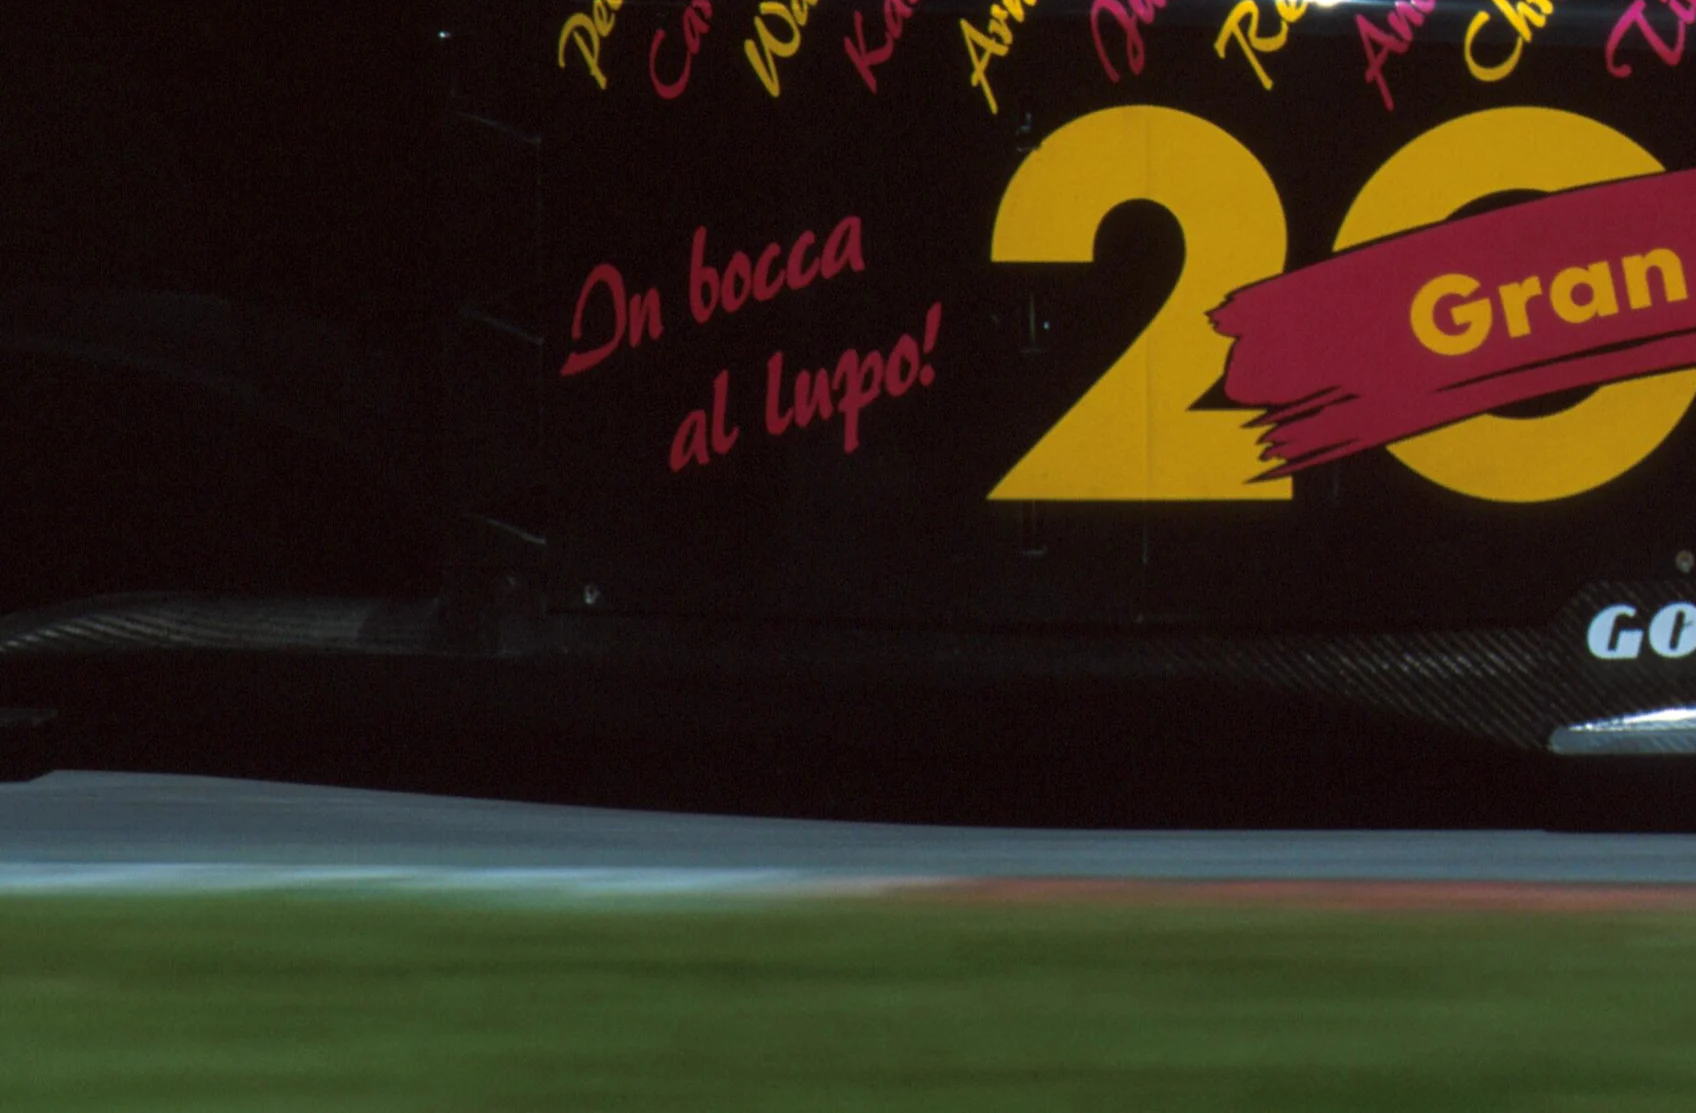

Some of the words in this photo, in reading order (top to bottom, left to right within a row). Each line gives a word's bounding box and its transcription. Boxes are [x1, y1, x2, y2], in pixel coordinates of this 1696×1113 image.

[688, 214, 866, 325] bocca
[1409, 244, 1690, 357] Gran
[669, 369, 740, 473] al
[765, 300, 943, 455] lupo!
